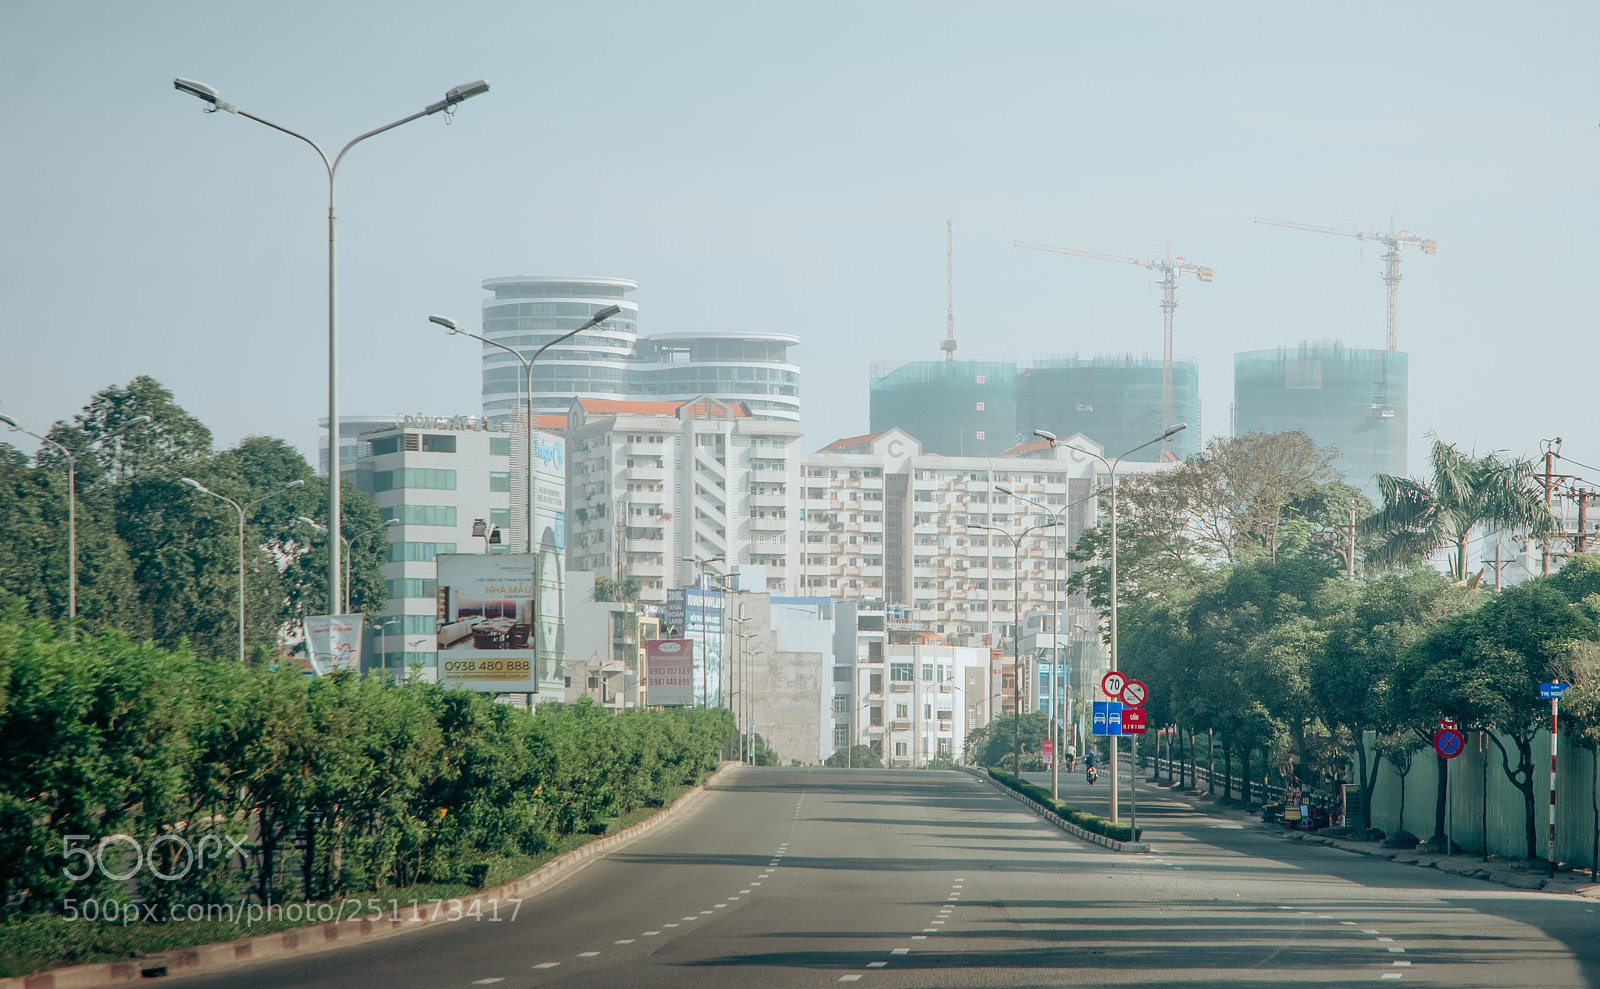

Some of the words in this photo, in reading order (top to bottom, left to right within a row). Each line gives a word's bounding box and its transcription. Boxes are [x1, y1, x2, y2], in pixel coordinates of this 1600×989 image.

[888, 439, 904, 458] C
[485, 584, 508, 594] NHÀ
[445, 661, 475, 671] 0938
[479, 661, 503, 671] 480
[507, 661, 530, 671] 888
[1109, 679, 1120, 690] 70
